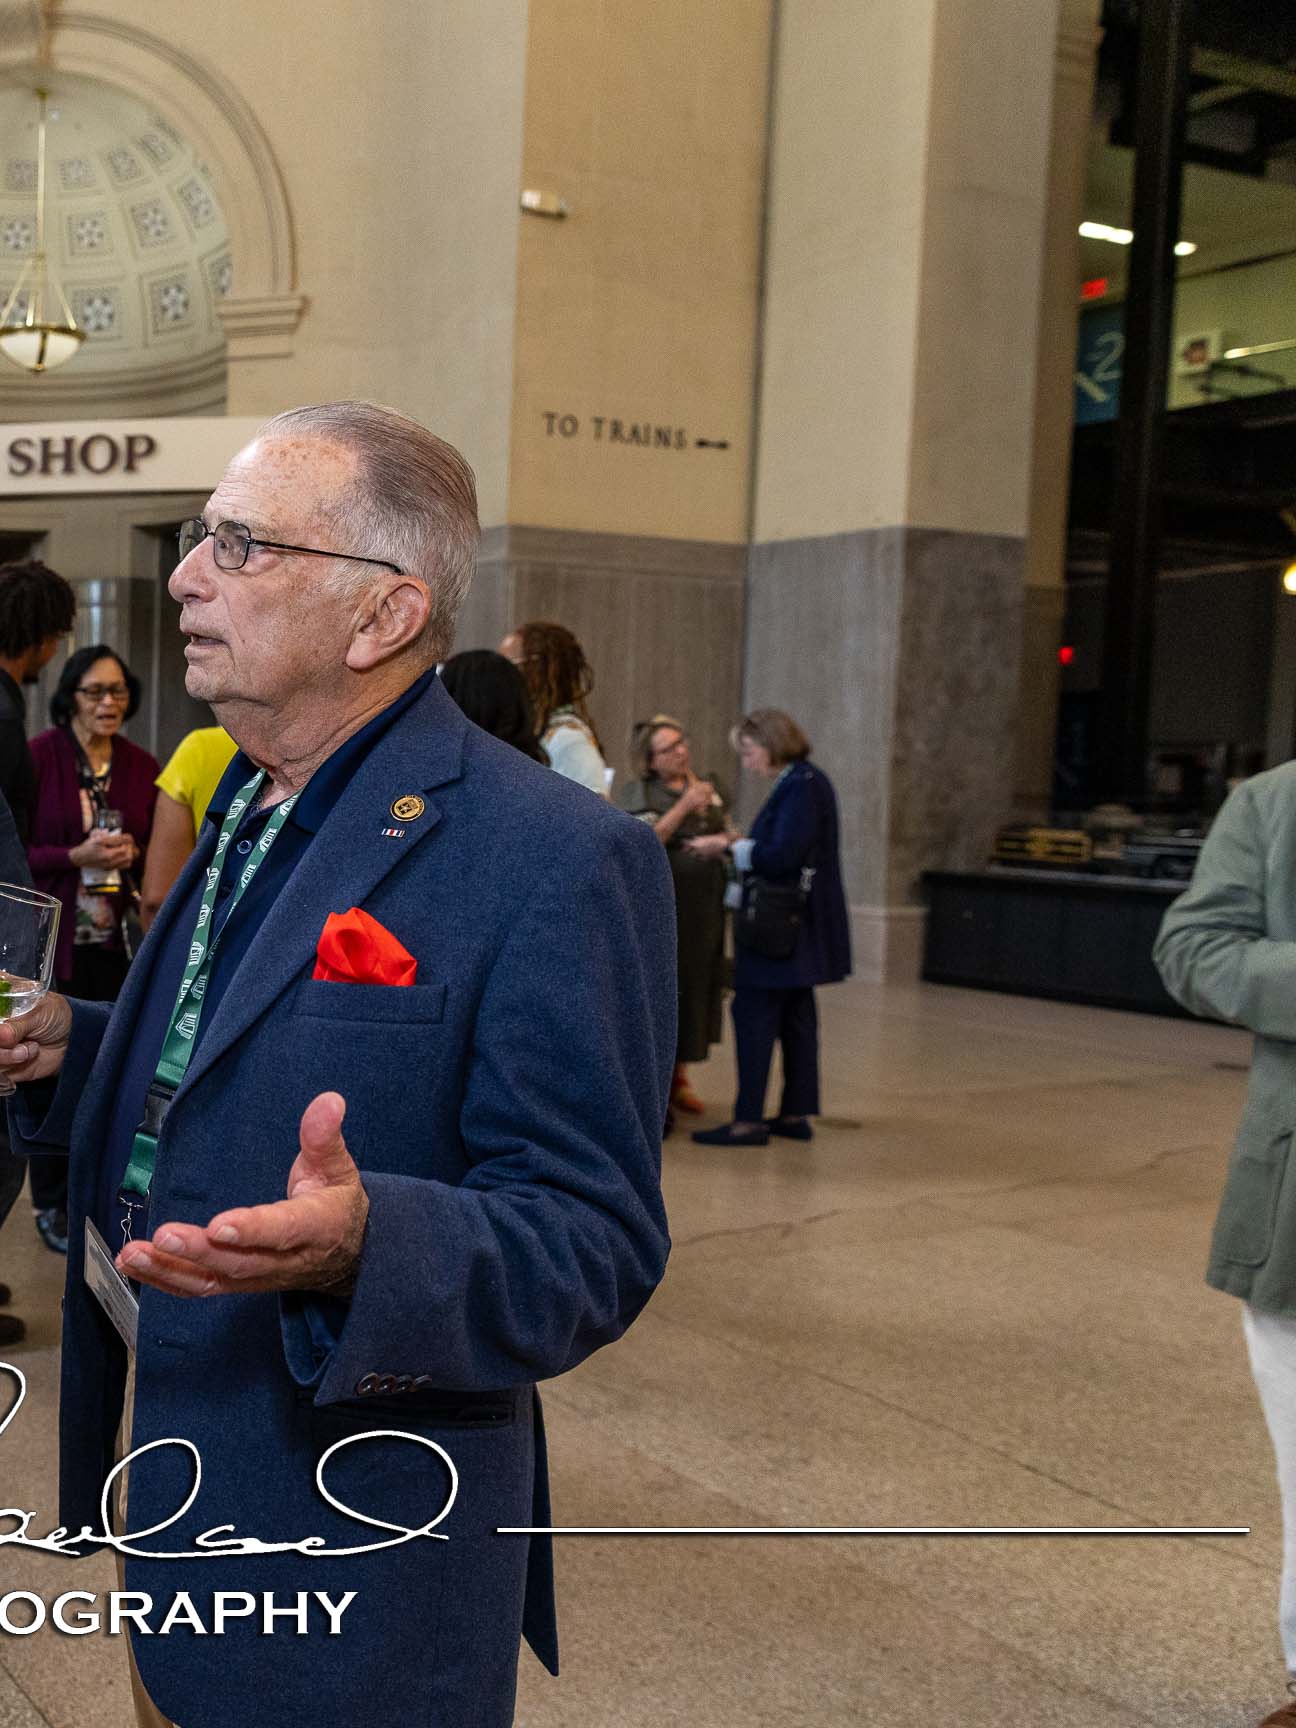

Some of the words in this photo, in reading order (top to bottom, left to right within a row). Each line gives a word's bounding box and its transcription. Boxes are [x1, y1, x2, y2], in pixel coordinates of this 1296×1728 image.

[541, 410, 580, 439] TO
[591, 415, 688, 451] TRAINS
[7, 433, 157, 478] SHOP
